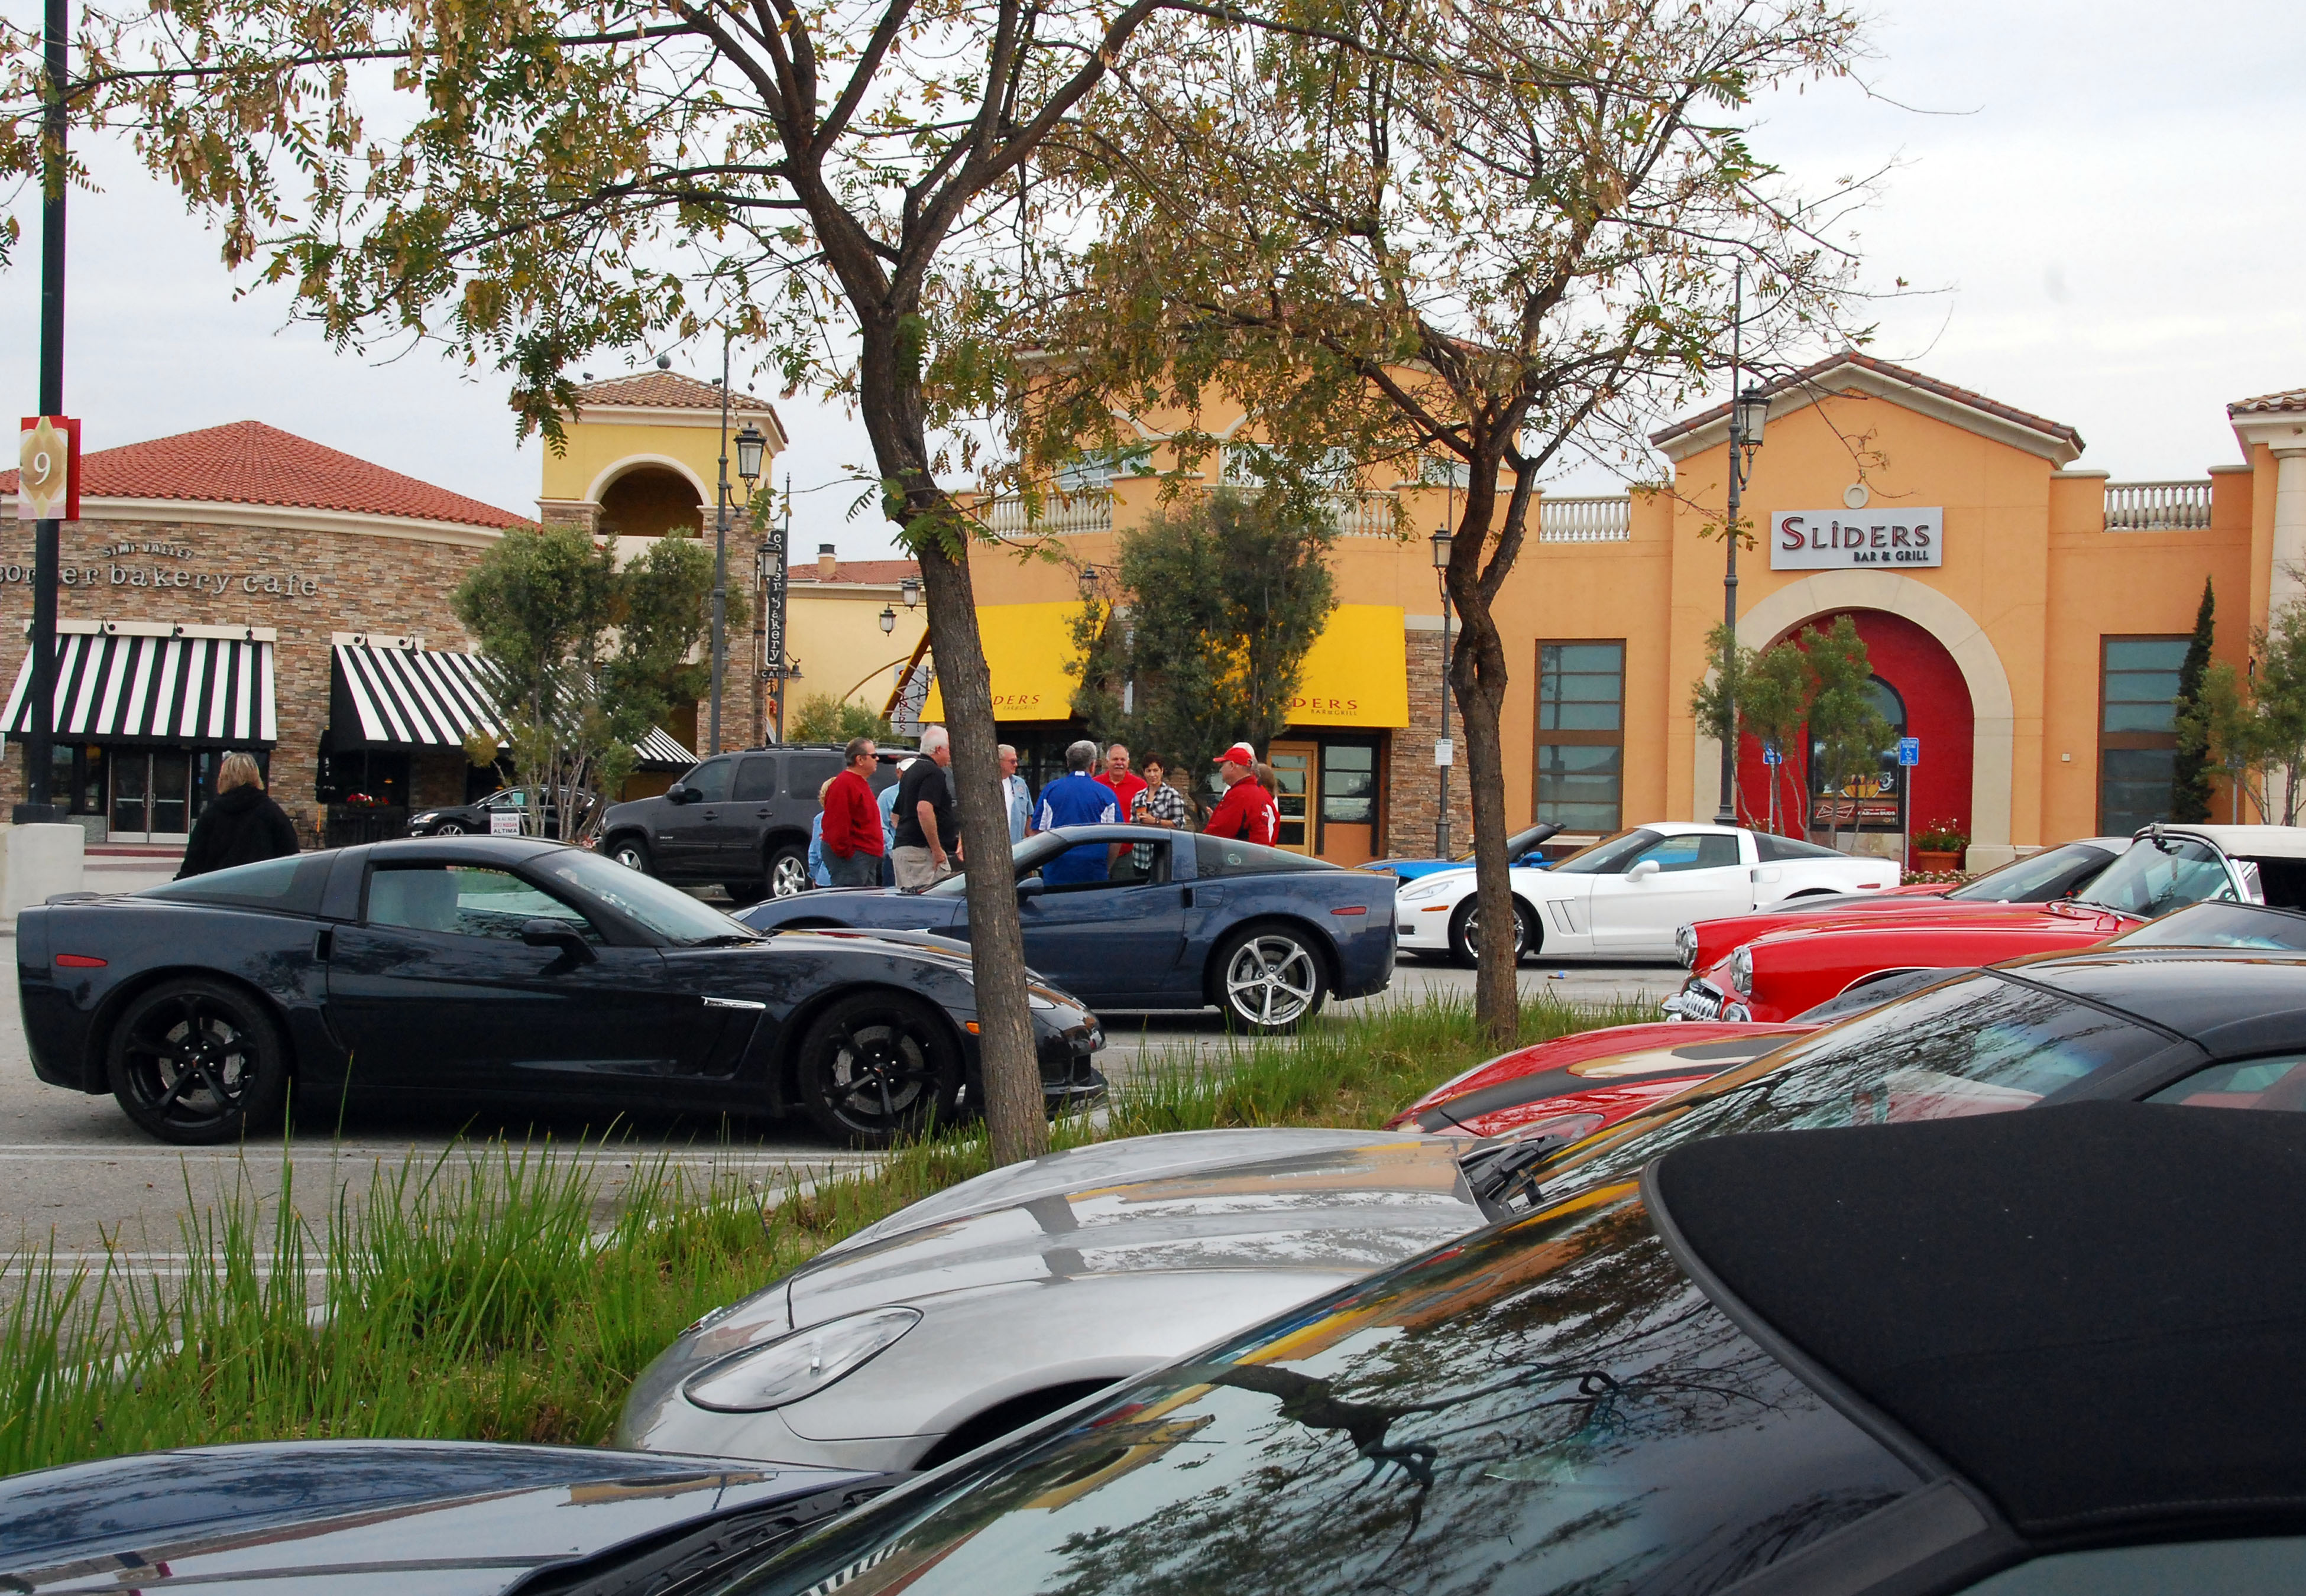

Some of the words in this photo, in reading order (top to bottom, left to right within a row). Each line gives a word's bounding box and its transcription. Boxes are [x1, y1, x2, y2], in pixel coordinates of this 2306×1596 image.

[33, 452, 51, 485] 9
[102, 543, 136, 557] SIMI
[142, 543, 194, 561] VALLEY
[1854, 552, 1877, 562] BAR
[1881, 551, 1891, 562] &
[1896, 550, 1929, 561] GRILL
[0, 565, 99, 585] orer
[109, 563, 232, 595] bakery
[243, 573, 319, 597] cafe
